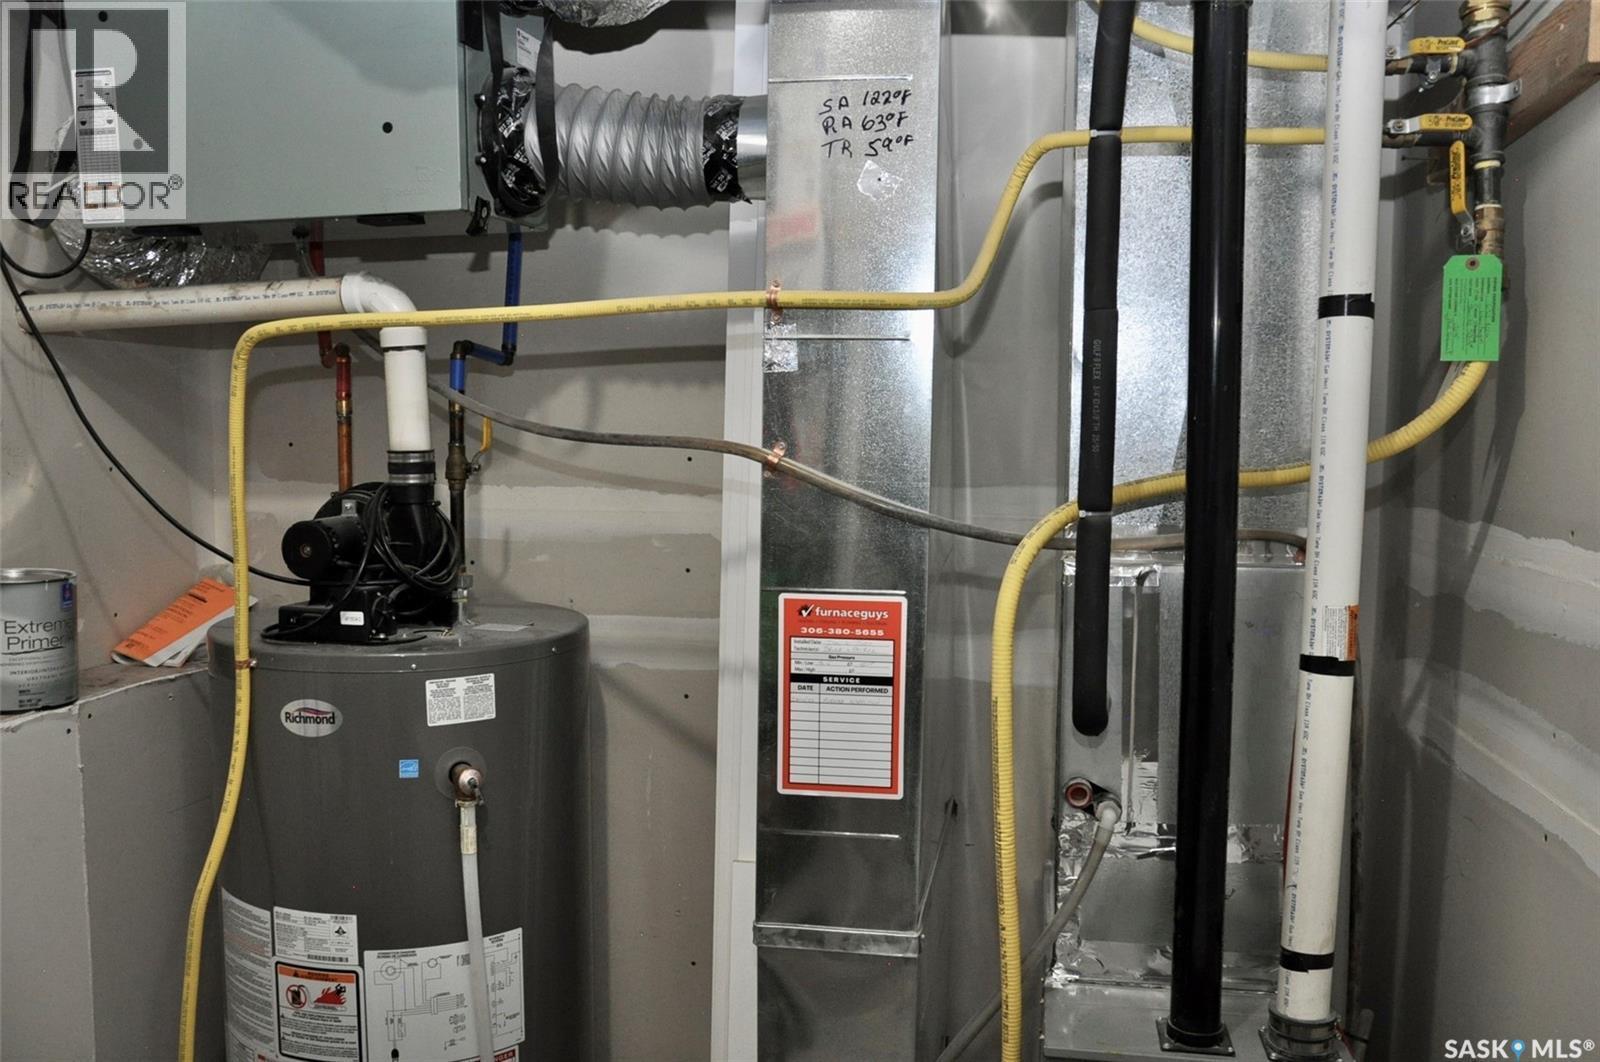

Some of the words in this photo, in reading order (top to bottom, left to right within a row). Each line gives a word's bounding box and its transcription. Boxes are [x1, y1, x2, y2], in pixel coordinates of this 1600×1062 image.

[815, 606, 889, 620] furnaceguys
[4, 620, 74, 635] Extrem
[7, 635, 65, 650] Primer
[822, 676, 861, 684] SERVICE
[851, 686, 889, 694] PERFORMED
[285, 711, 336, 726] Richmond
